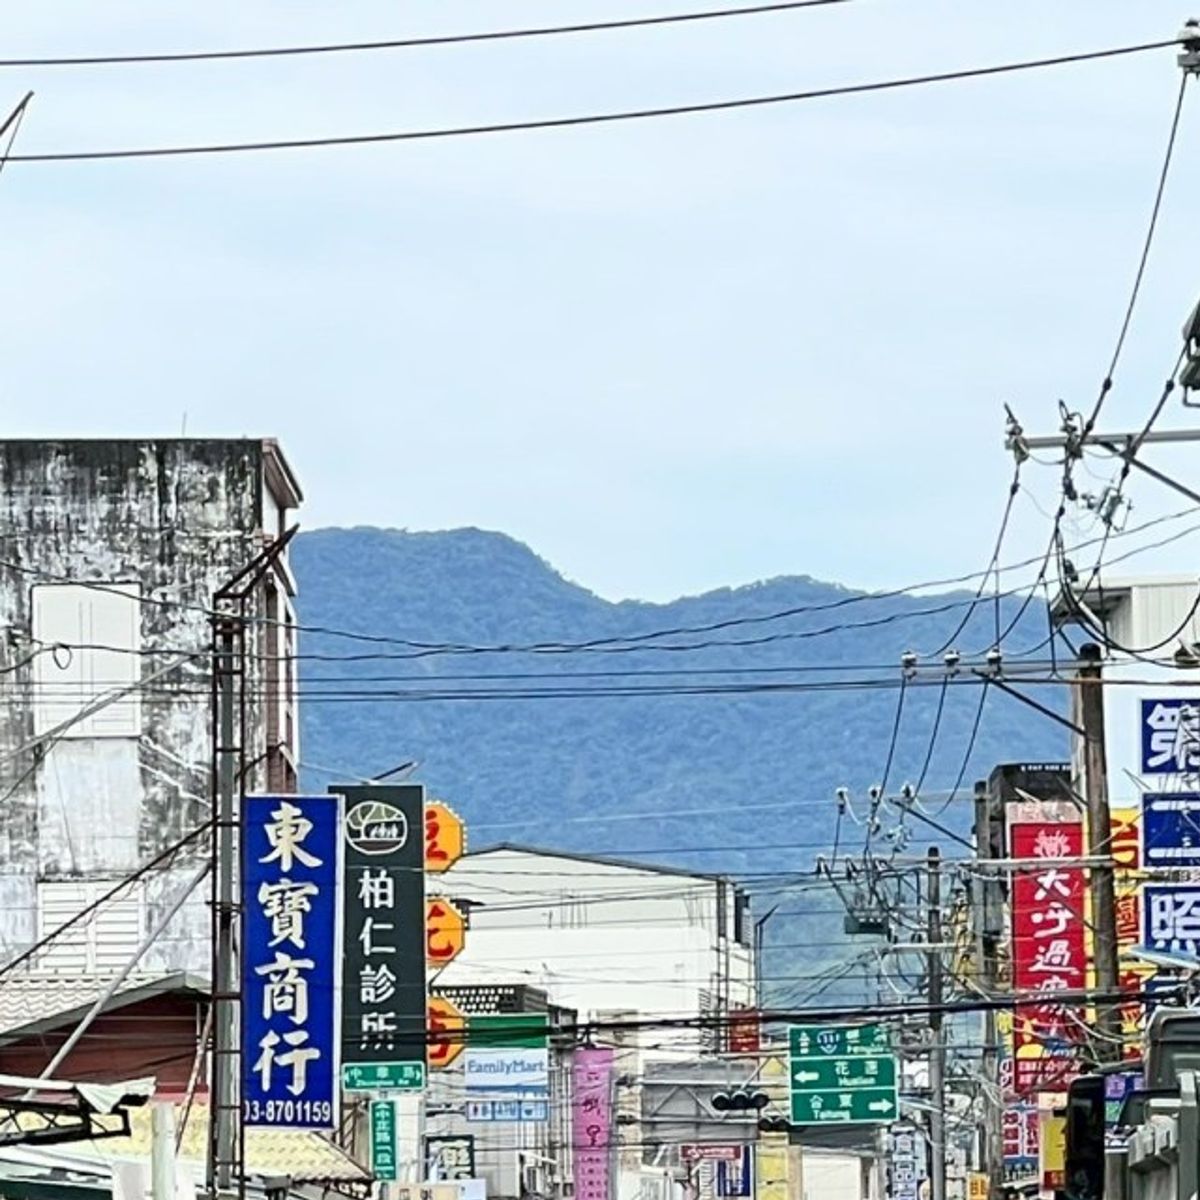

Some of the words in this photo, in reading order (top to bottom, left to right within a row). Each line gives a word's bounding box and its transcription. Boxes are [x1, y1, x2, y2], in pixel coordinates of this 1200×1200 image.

[252, 800, 324, 1096] 東寶商行
[358, 868, 398, 1051] 柏仁診所
[467, 1059, 545, 1074] FamilyMart
